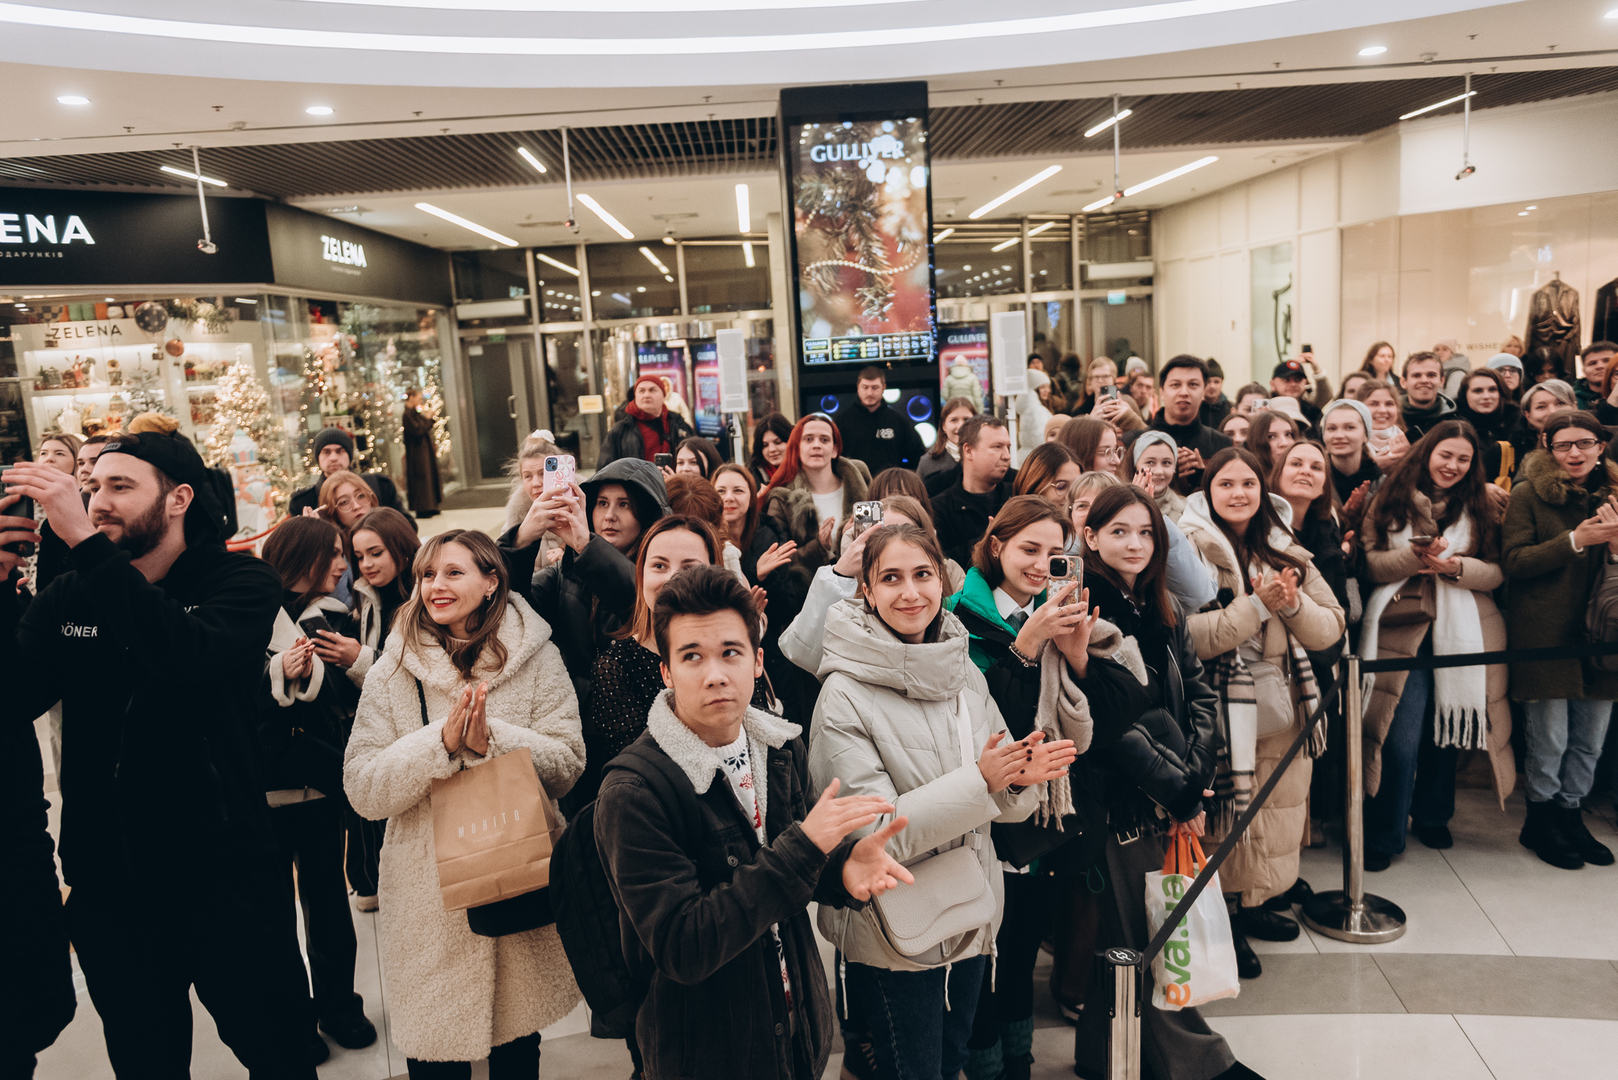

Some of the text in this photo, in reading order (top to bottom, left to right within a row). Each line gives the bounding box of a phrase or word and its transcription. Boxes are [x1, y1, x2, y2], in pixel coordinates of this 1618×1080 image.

[810, 142, 905, 163] GULLIVER
[320, 234, 368, 268] ZELENA
[50, 324, 123, 340] ZELENA
[1466, 341, 1501, 351] WISHE
[458, 809, 520, 838] MOHITO
